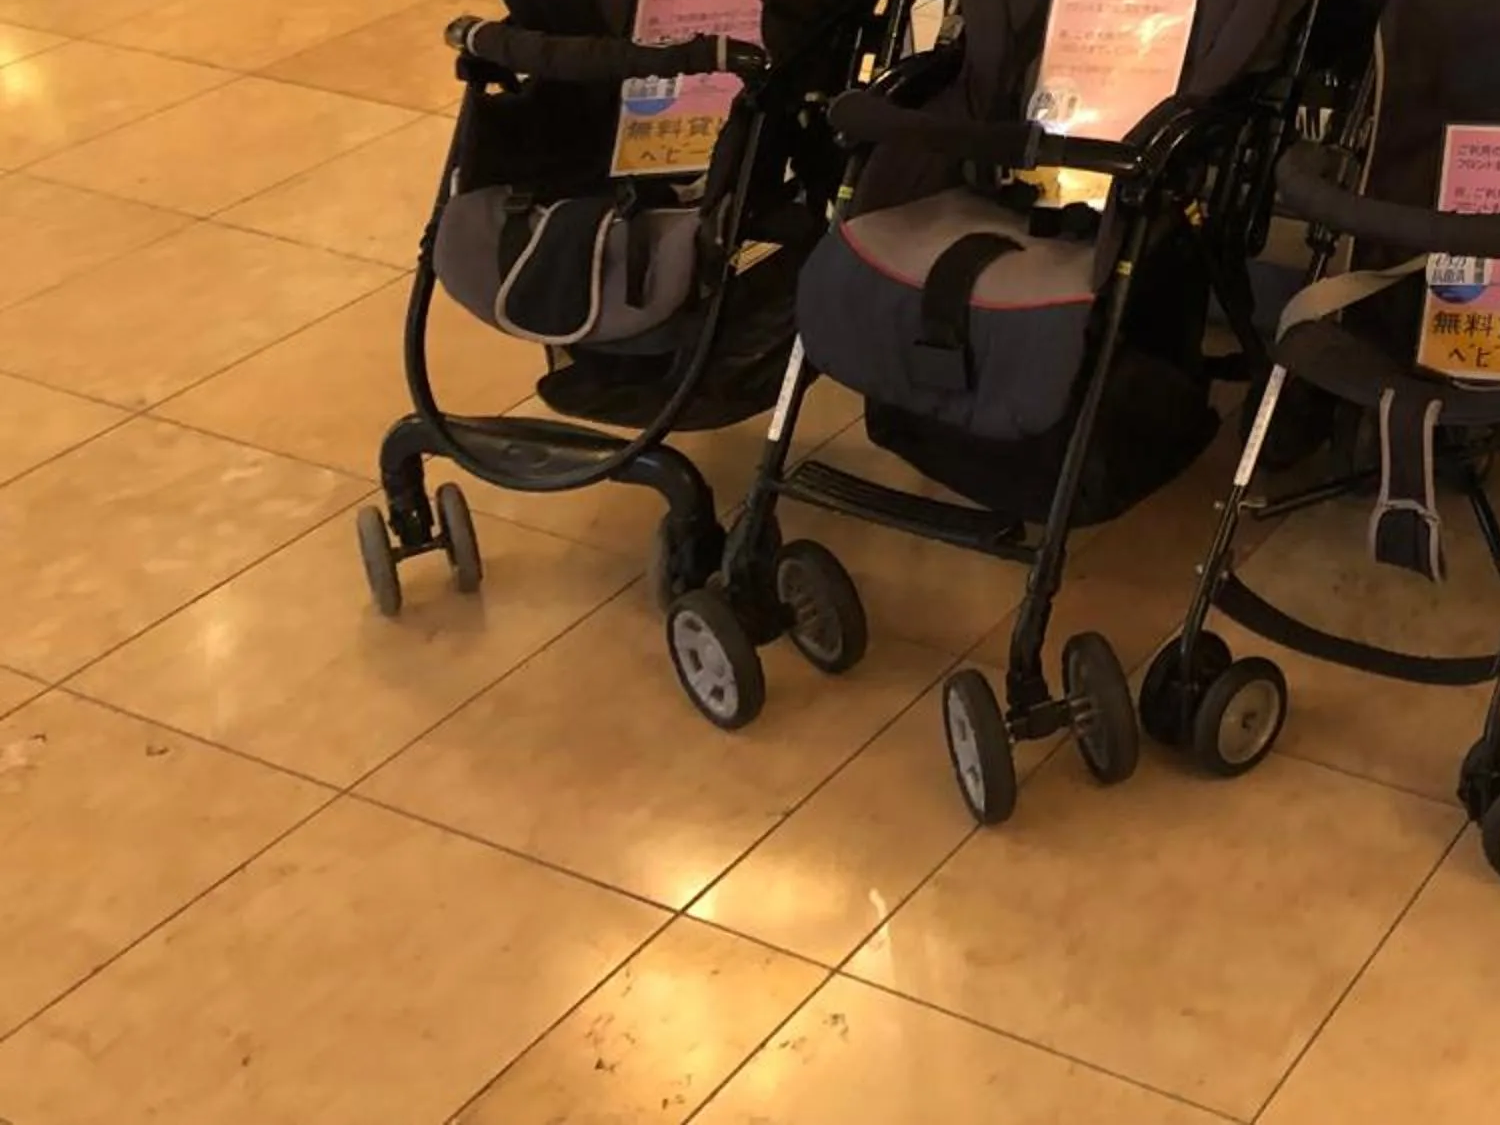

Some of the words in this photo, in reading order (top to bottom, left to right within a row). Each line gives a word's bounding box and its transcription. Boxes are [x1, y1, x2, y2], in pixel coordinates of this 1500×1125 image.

[623, 115, 724, 139] 無料貸
[640, 142, 708, 164] ベビー
